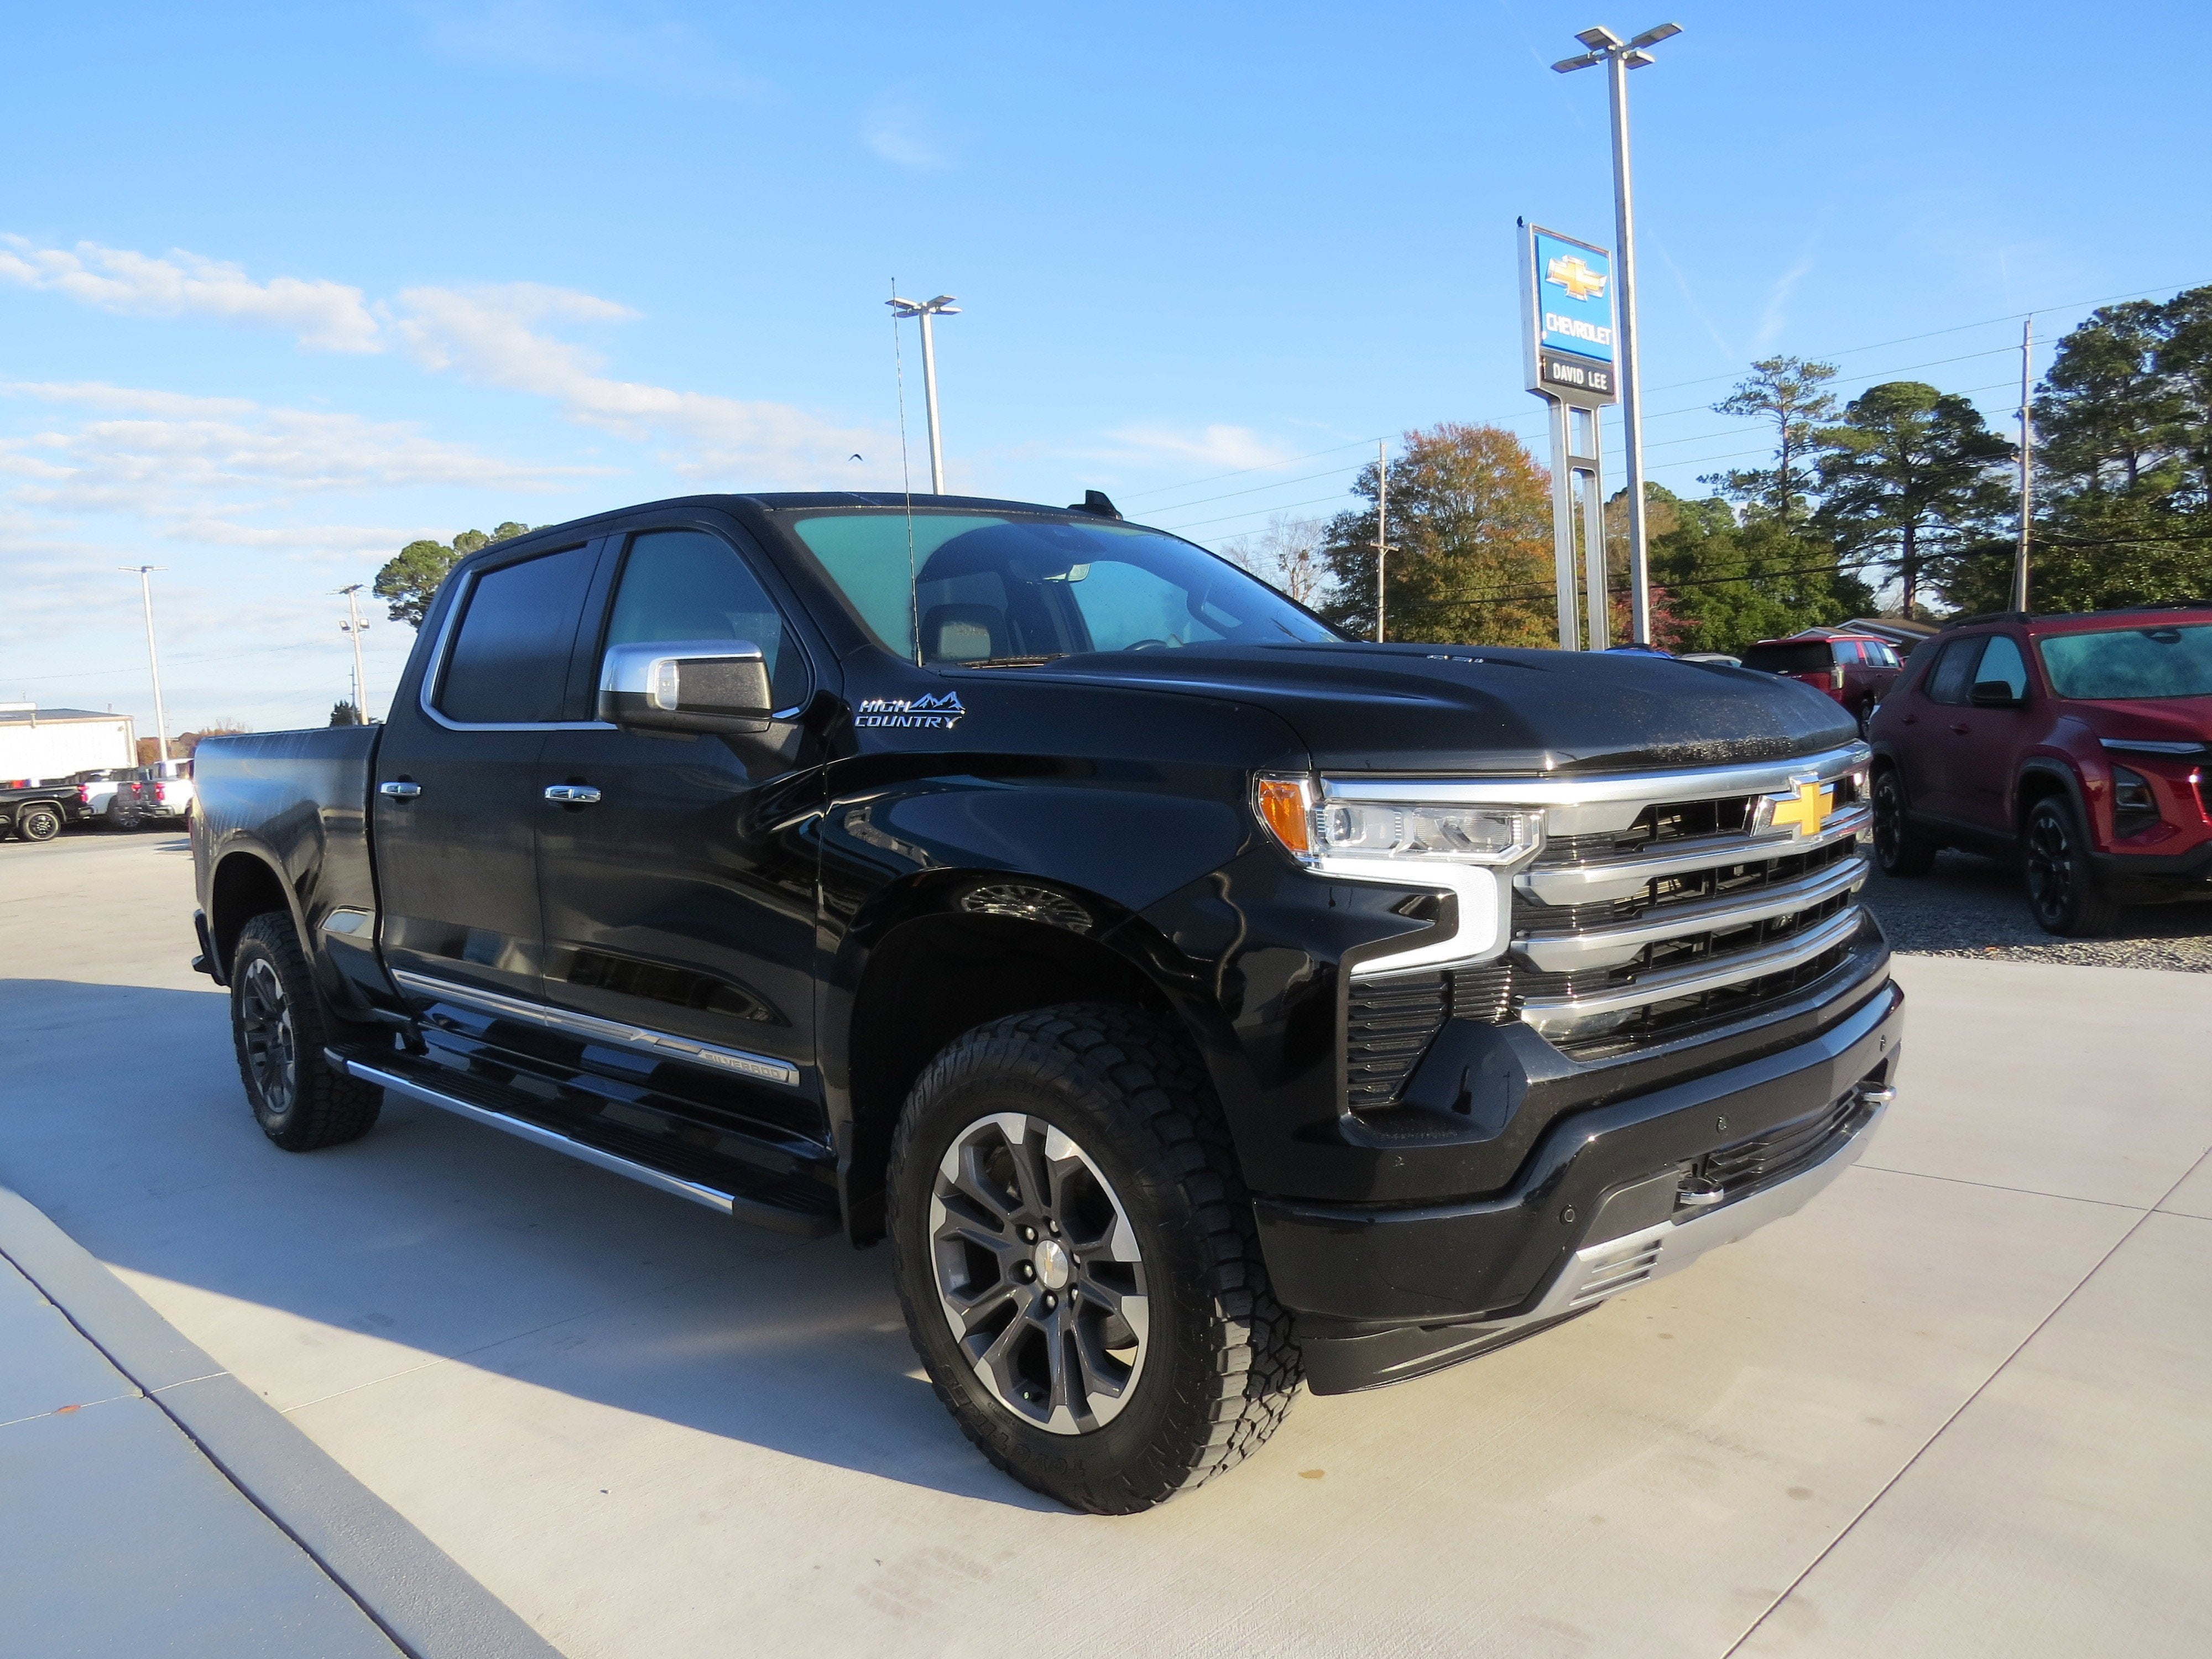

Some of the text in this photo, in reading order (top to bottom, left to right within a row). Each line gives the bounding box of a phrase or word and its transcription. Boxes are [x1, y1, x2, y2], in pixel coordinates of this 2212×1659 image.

[1546, 312, 1611, 346] CHEVROLET
[1553, 362, 1607, 390] DAVID LEE
[858, 699, 911, 713] HIGH
[854, 716, 962, 729] COUNTRY
[705, 1053, 780, 1077] SILVERADO
